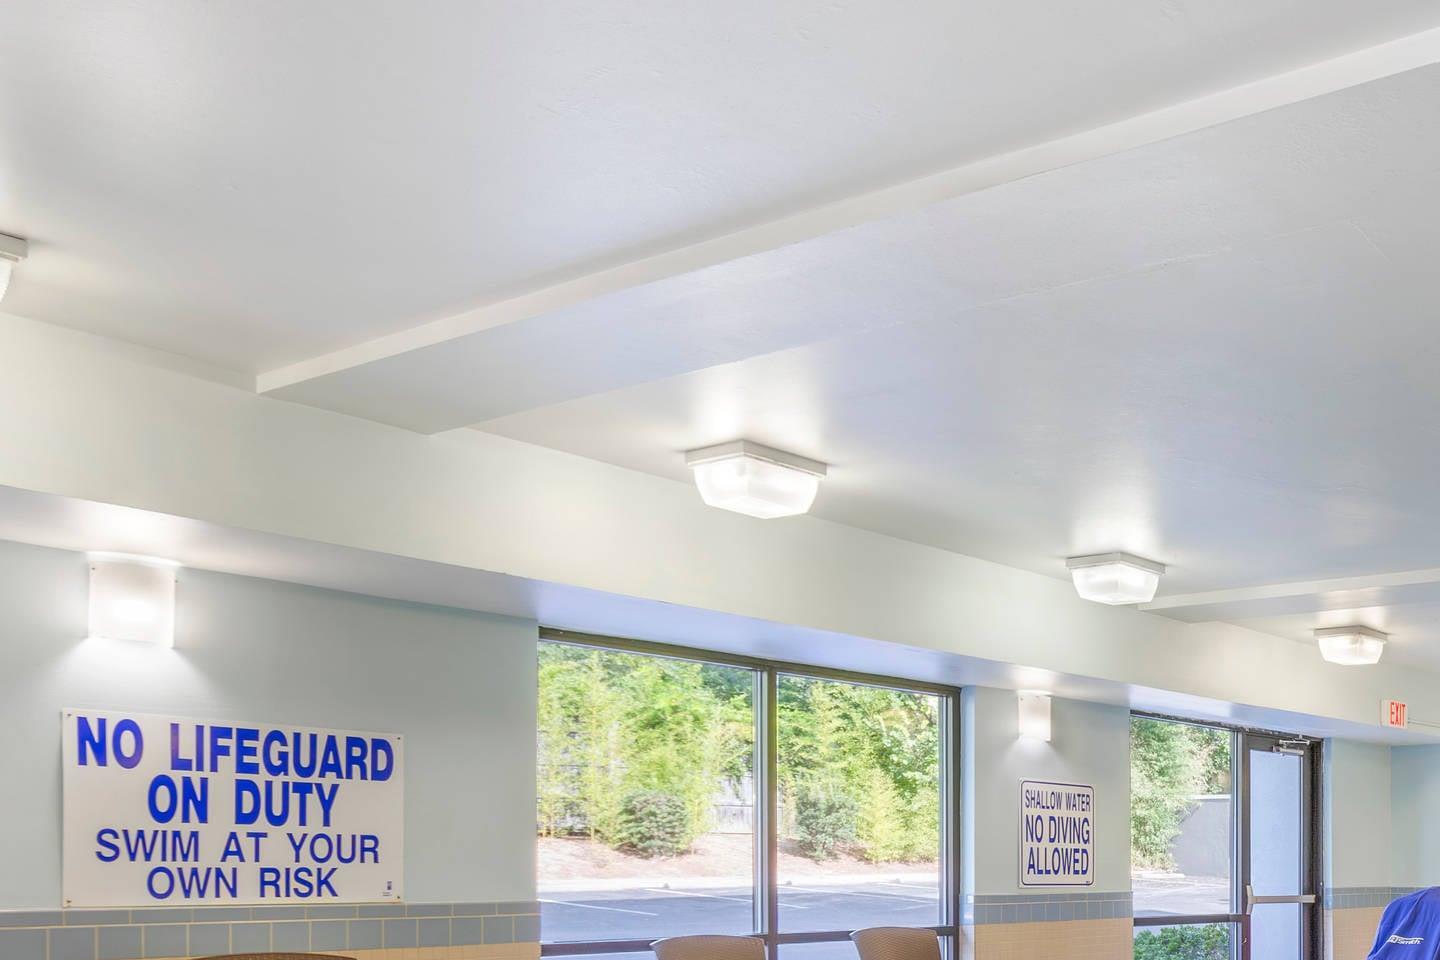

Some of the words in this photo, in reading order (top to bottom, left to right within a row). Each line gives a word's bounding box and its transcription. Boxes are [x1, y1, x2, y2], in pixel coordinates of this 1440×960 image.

[1390, 701, 1406, 727] EXIT
[77, 716, 144, 769] NO
[170, 722, 394, 781] LIFEGUARD
[147, 774, 209, 824] ON
[234, 778, 340, 827] DUTY
[1025, 789, 1062, 810] SHALLOW
[1065, 793, 1091, 812] WATER
[1025, 814, 1044, 843] NO
[1048, 816, 1090, 844] DIVING
[95, 828, 200, 863] SWIM
[220, 831, 268, 863] AT
[287, 833, 380, 864] YOUR
[1027, 847, 1089, 875] ALLOWED
[147, 866, 238, 900] OWN
[259, 867, 338, 899] RISK
